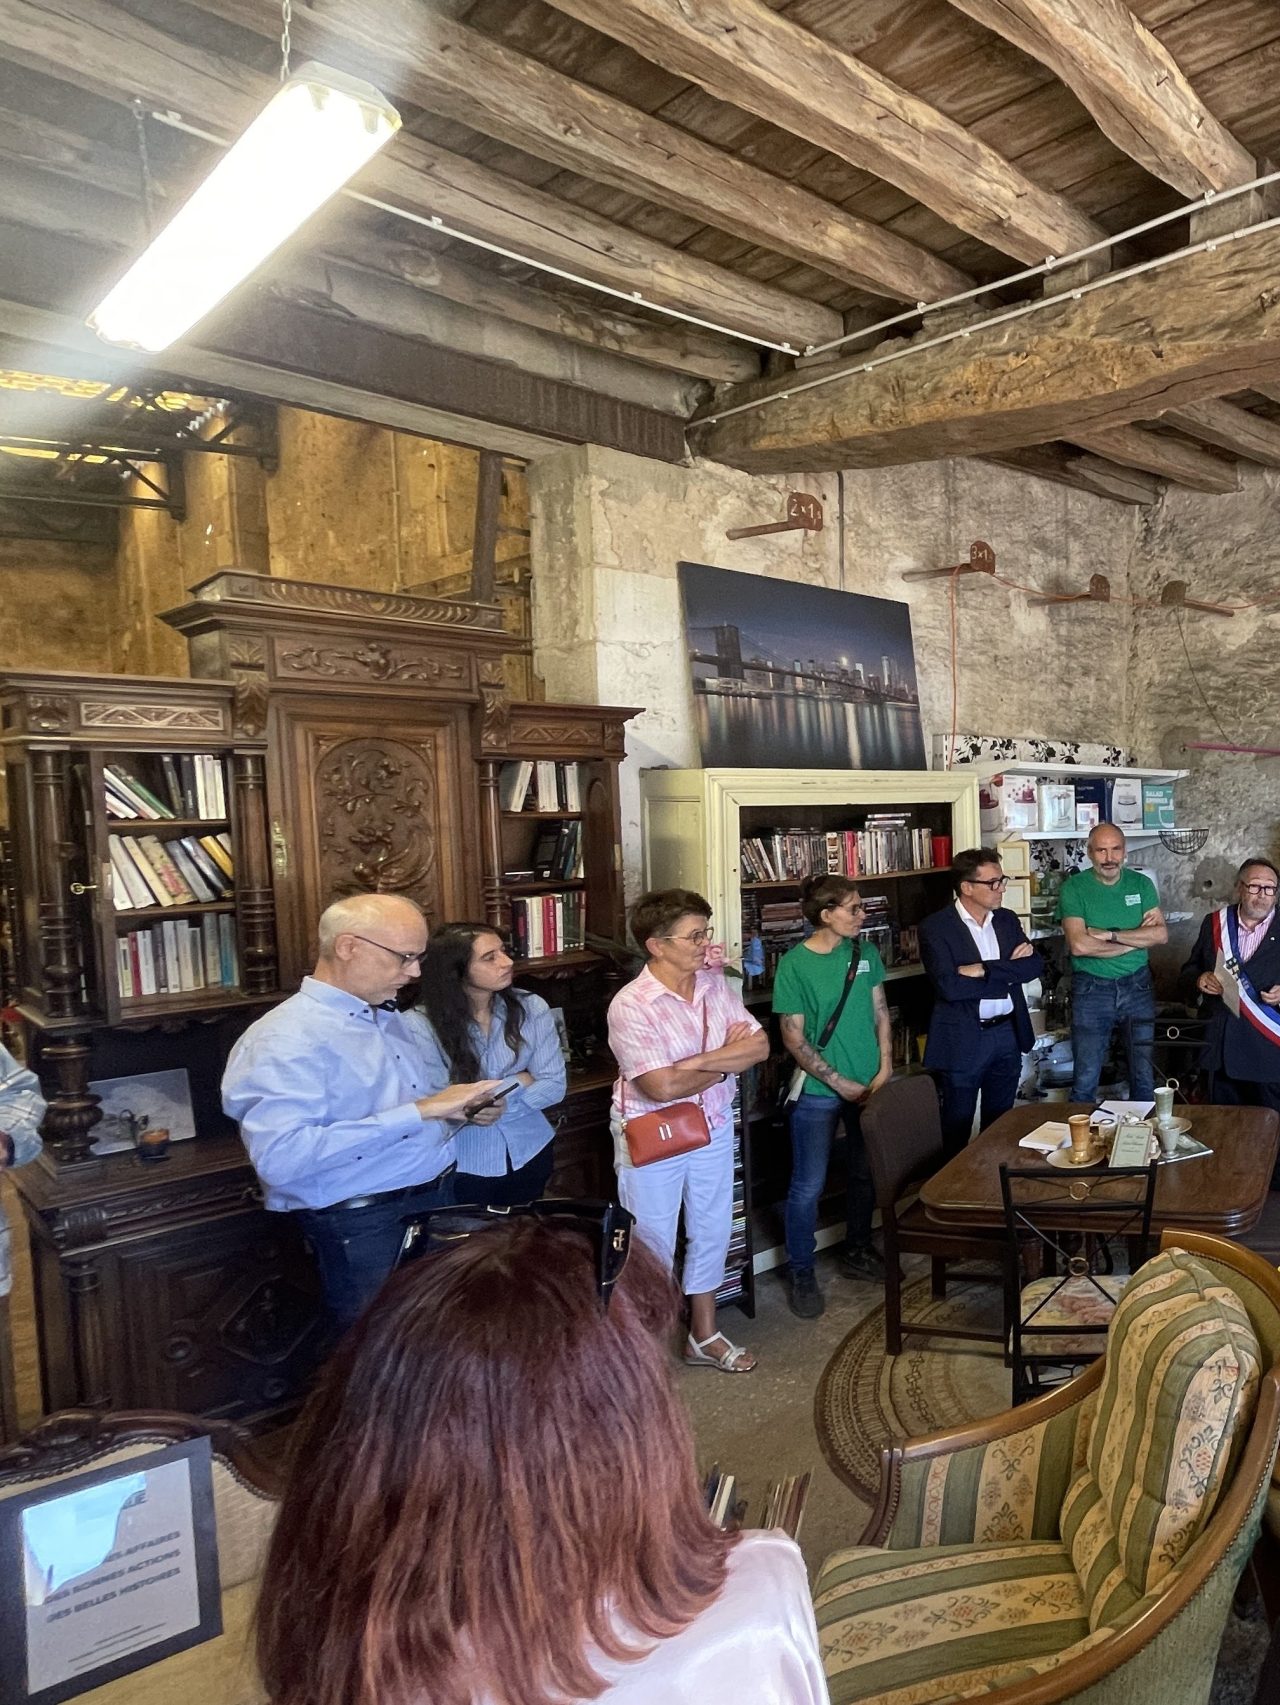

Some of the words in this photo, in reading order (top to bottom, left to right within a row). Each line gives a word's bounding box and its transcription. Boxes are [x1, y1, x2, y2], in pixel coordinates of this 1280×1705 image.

[127, 1548, 181, 1573] ACTIONS
[74, 1591, 117, 1613] BELLES
[119, 1567, 181, 1596] HISTOIRES
